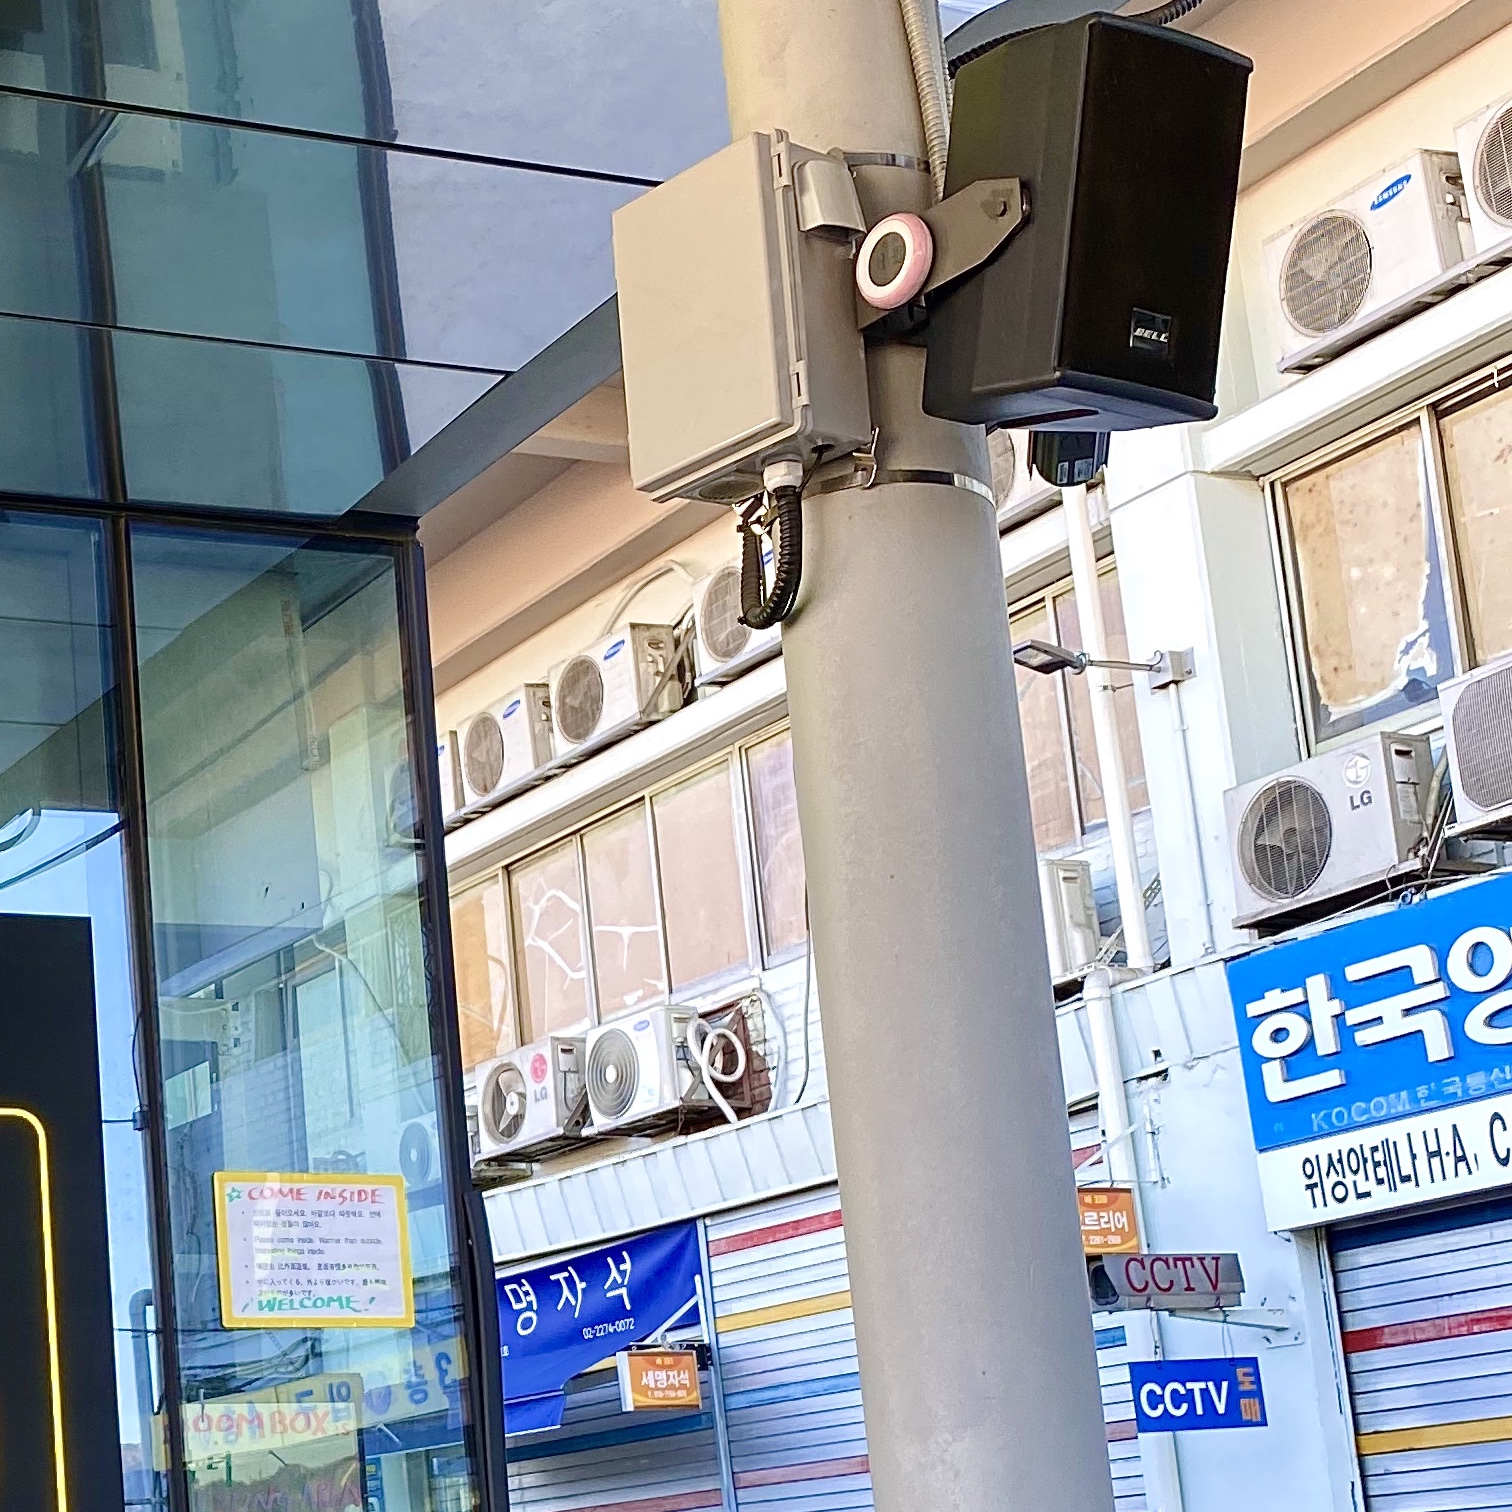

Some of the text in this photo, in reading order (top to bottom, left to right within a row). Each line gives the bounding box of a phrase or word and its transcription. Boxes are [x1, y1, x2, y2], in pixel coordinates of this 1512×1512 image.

[1349, 789, 1373, 811] LG
[1301, 1137, 1420, 1209] 위성안테나
[247, 1186, 385, 1206] COME INSIDE
[1124, 1256, 1221, 1294] CCTV
[640, 1369, 690, 1389] 세명자석
[1139, 1380, 1229, 1419] CCTV
